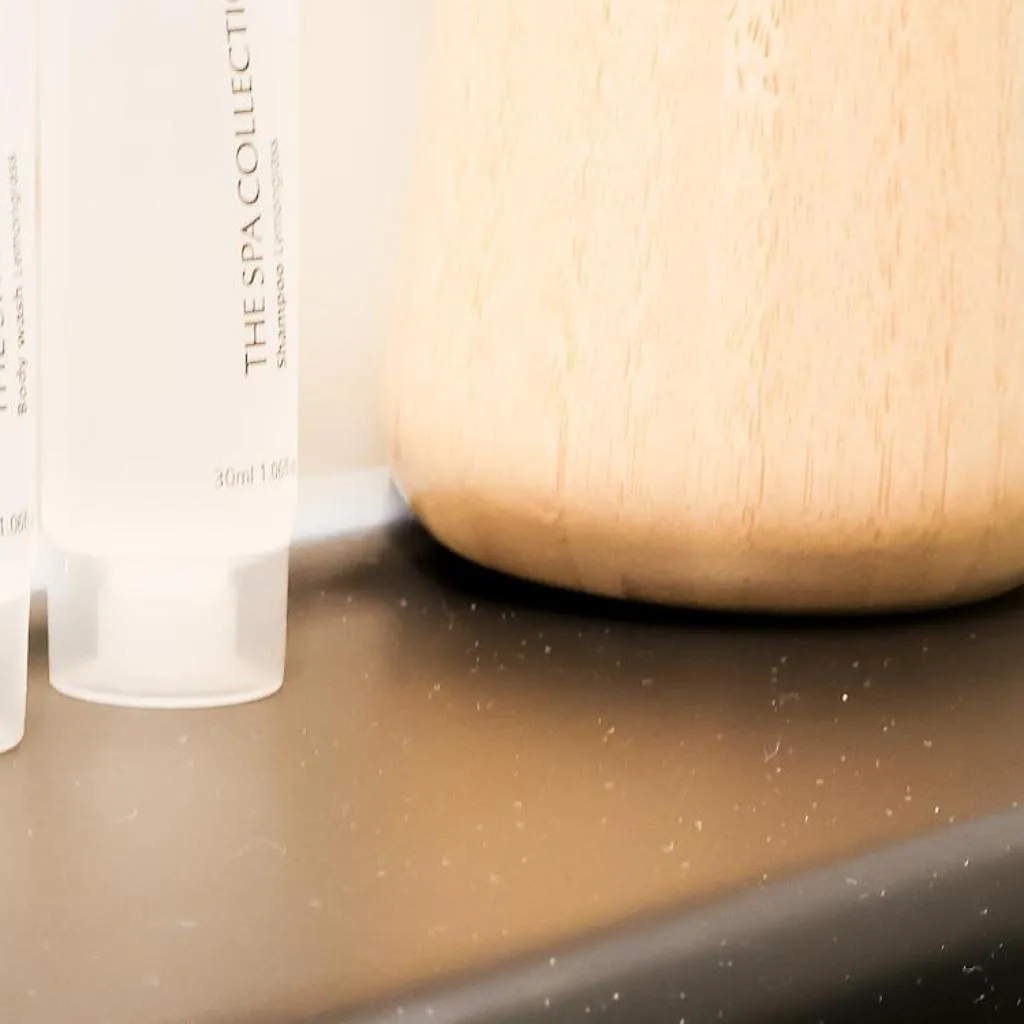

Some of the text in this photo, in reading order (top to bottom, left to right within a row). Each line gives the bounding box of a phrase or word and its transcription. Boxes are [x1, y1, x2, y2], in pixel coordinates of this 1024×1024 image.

[240, 214, 266, 287] SPA
[14, 286, 27, 348] wash
[241, 295, 268, 376] THE
[275, 262, 287, 370] Shampoo
[16, 356, 29, 416] Body
[213, 463, 254, 491] 30ml
